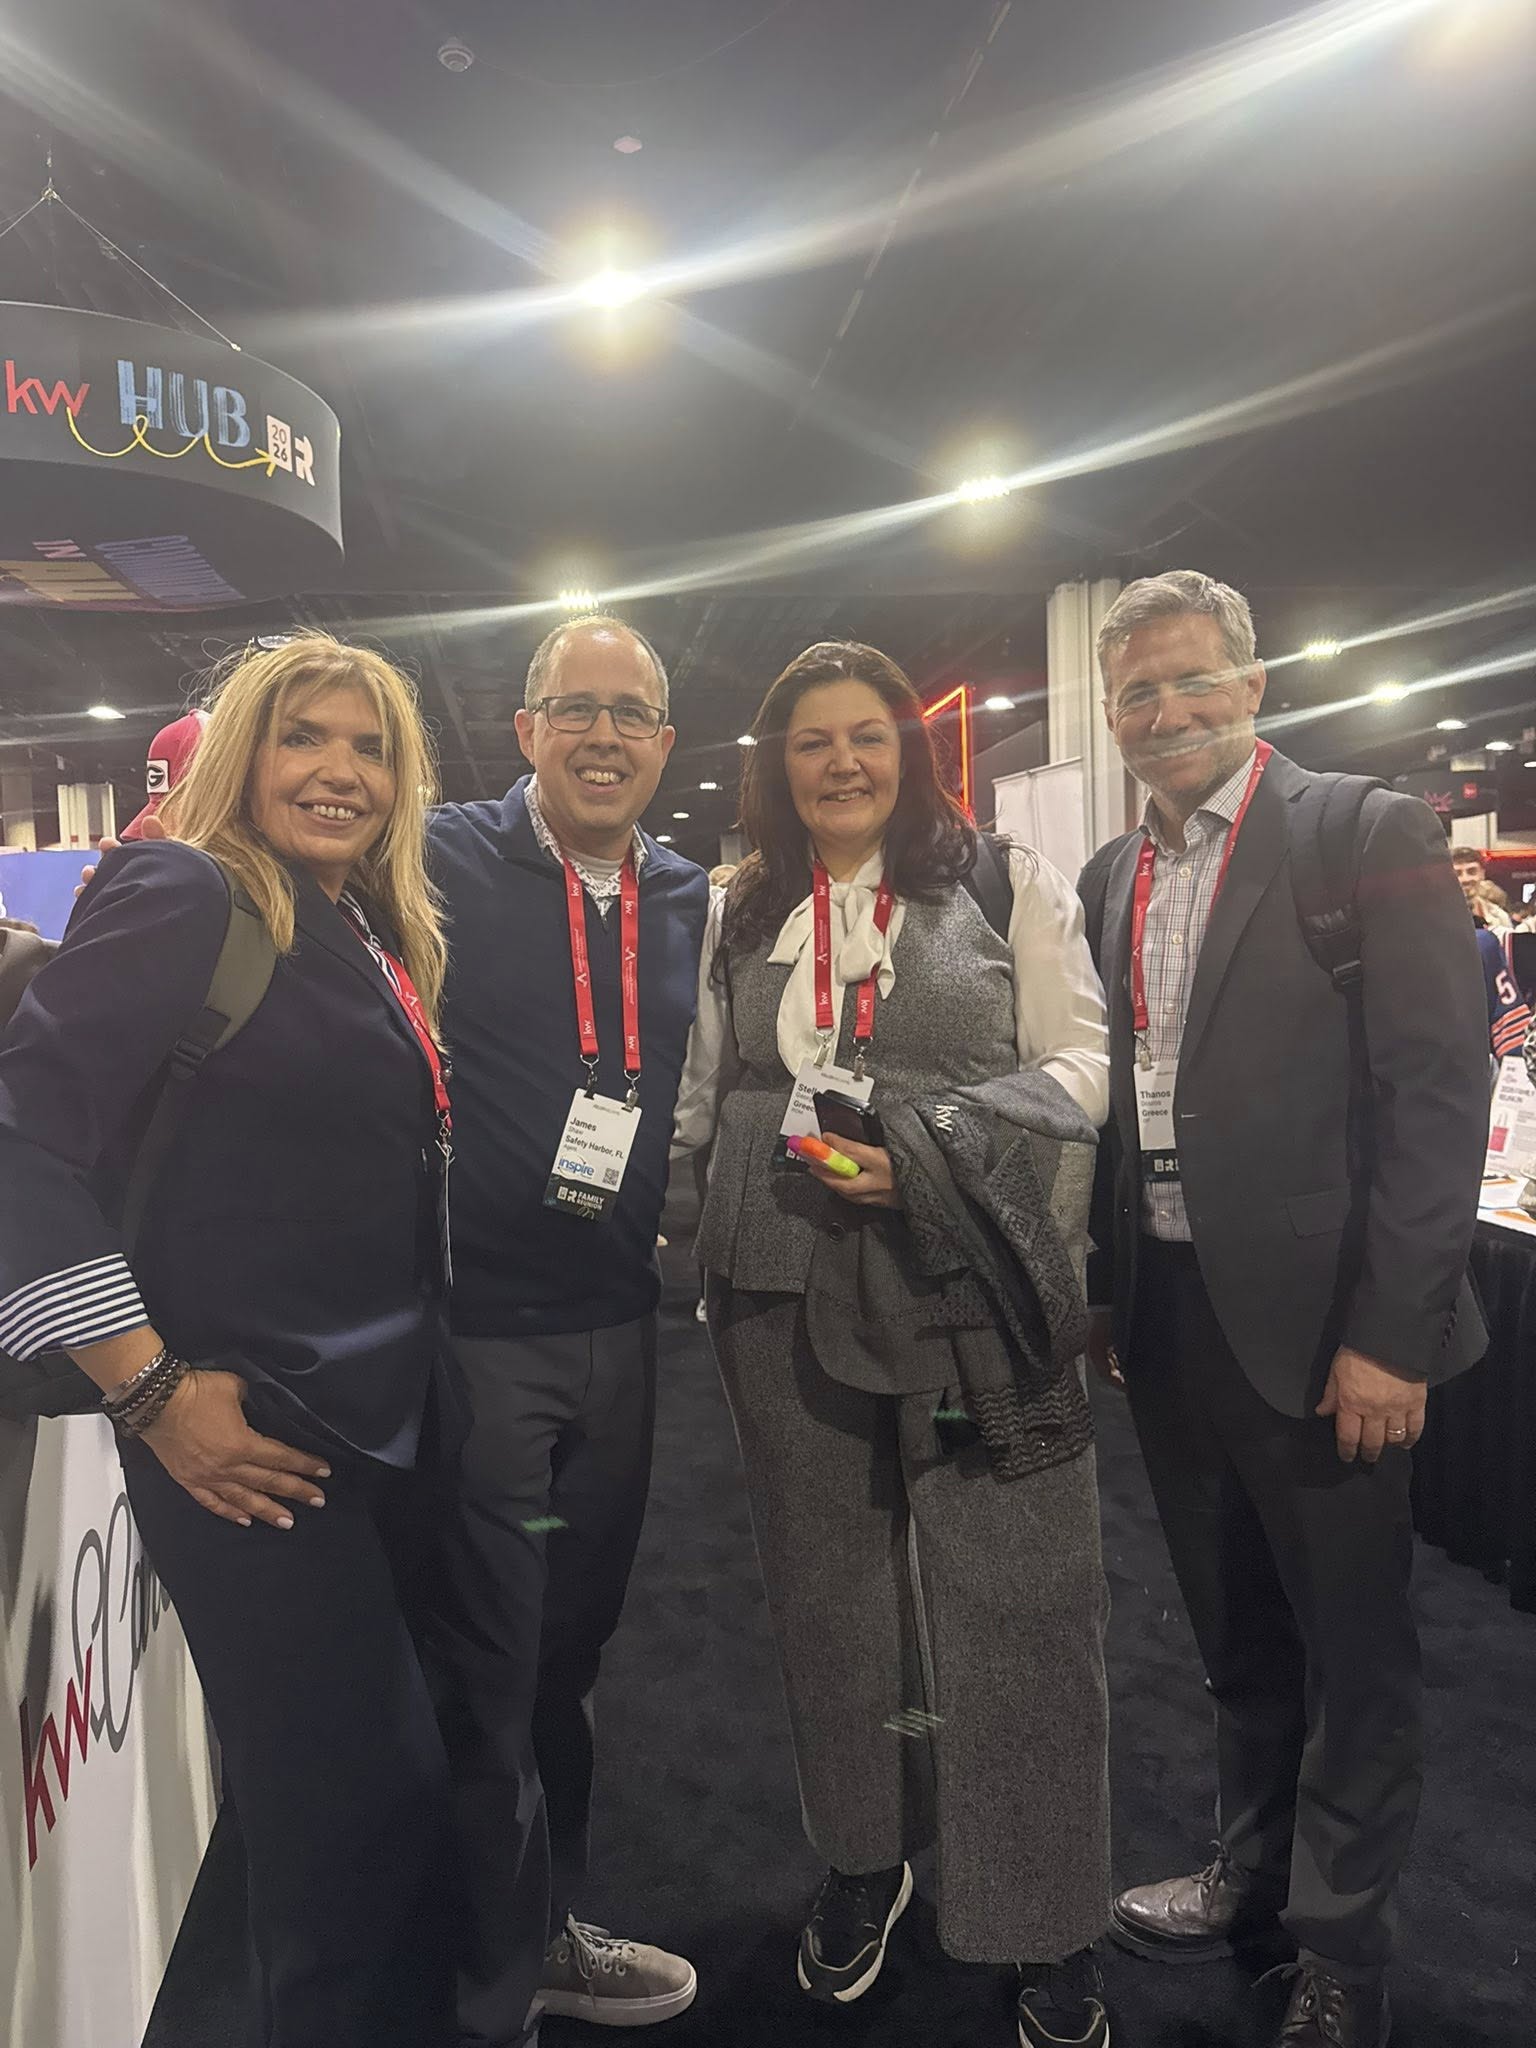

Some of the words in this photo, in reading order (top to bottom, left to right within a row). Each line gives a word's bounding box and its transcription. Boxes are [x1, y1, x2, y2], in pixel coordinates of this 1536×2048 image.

[4, 360, 90, 417] kw
[117, 360, 251, 448] HUB
[272, 425, 287, 444] 20
[273, 443, 288, 462] 26
[571, 882, 580, 897] kw
[624, 900, 634, 915] kw
[1495, 971, 1517, 1005] 5
[819, 992, 829, 1006] kw
[861, 999, 871, 1014] kw
[583, 1020, 592, 1035] kw
[627, 1035, 636, 1049] kw
[797, 1083, 818, 1095] Stell
[1140, 1091, 1171, 1099] Thanos
[793, 1100, 816, 1112] Greec
[1142, 1109, 1168, 1117] Greece
[570, 1117, 597, 1131] James
[935, 1104, 960, 1132] kw
[565, 1135, 588, 1149] Safety
[588, 1142, 614, 1157] Harbor,
[615, 1151, 624, 1159] FL
[559, 1158, 594, 1175] inspire
[577, 1191, 605, 1205] FAMILY
[19, 1643, 93, 1871] kw
